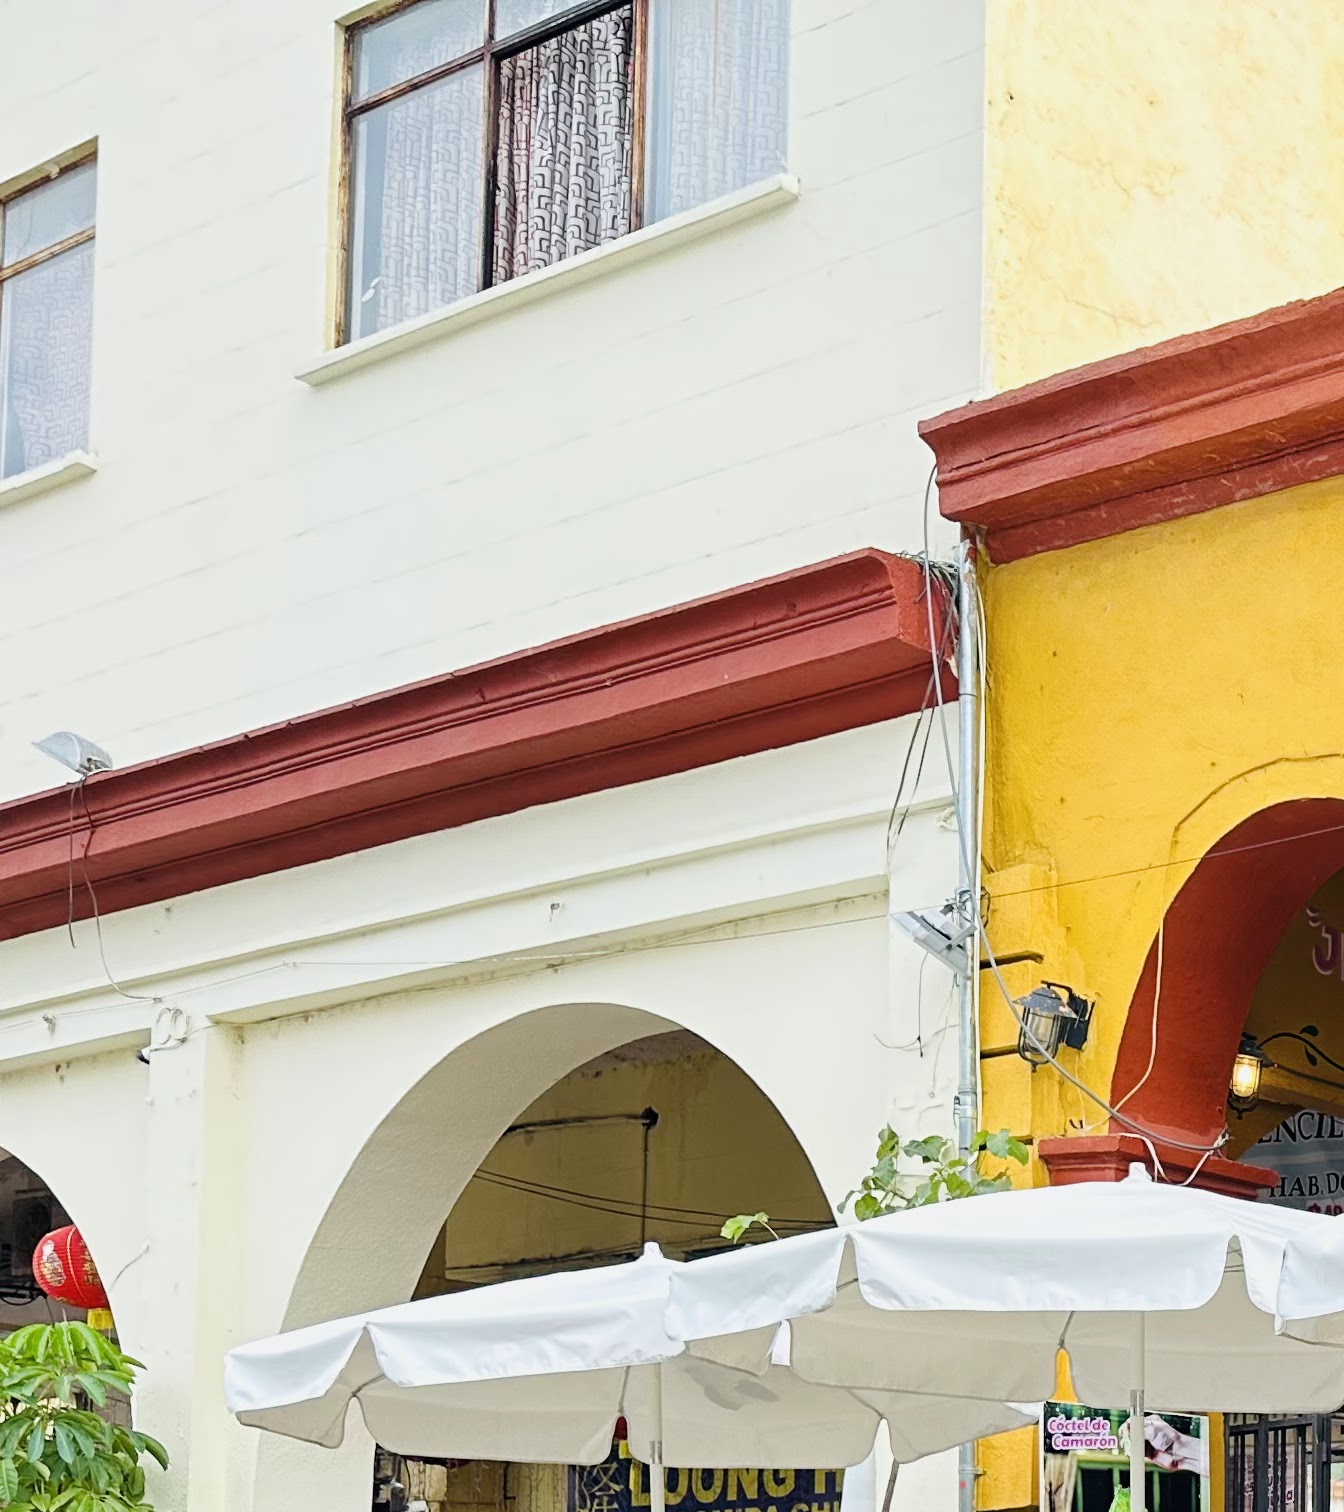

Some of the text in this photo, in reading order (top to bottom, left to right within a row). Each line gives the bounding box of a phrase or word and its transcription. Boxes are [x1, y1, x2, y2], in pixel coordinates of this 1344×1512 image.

[1049, 1416, 1109, 1431] Cóctel de
[1053, 1432, 1116, 1448] Camarón
